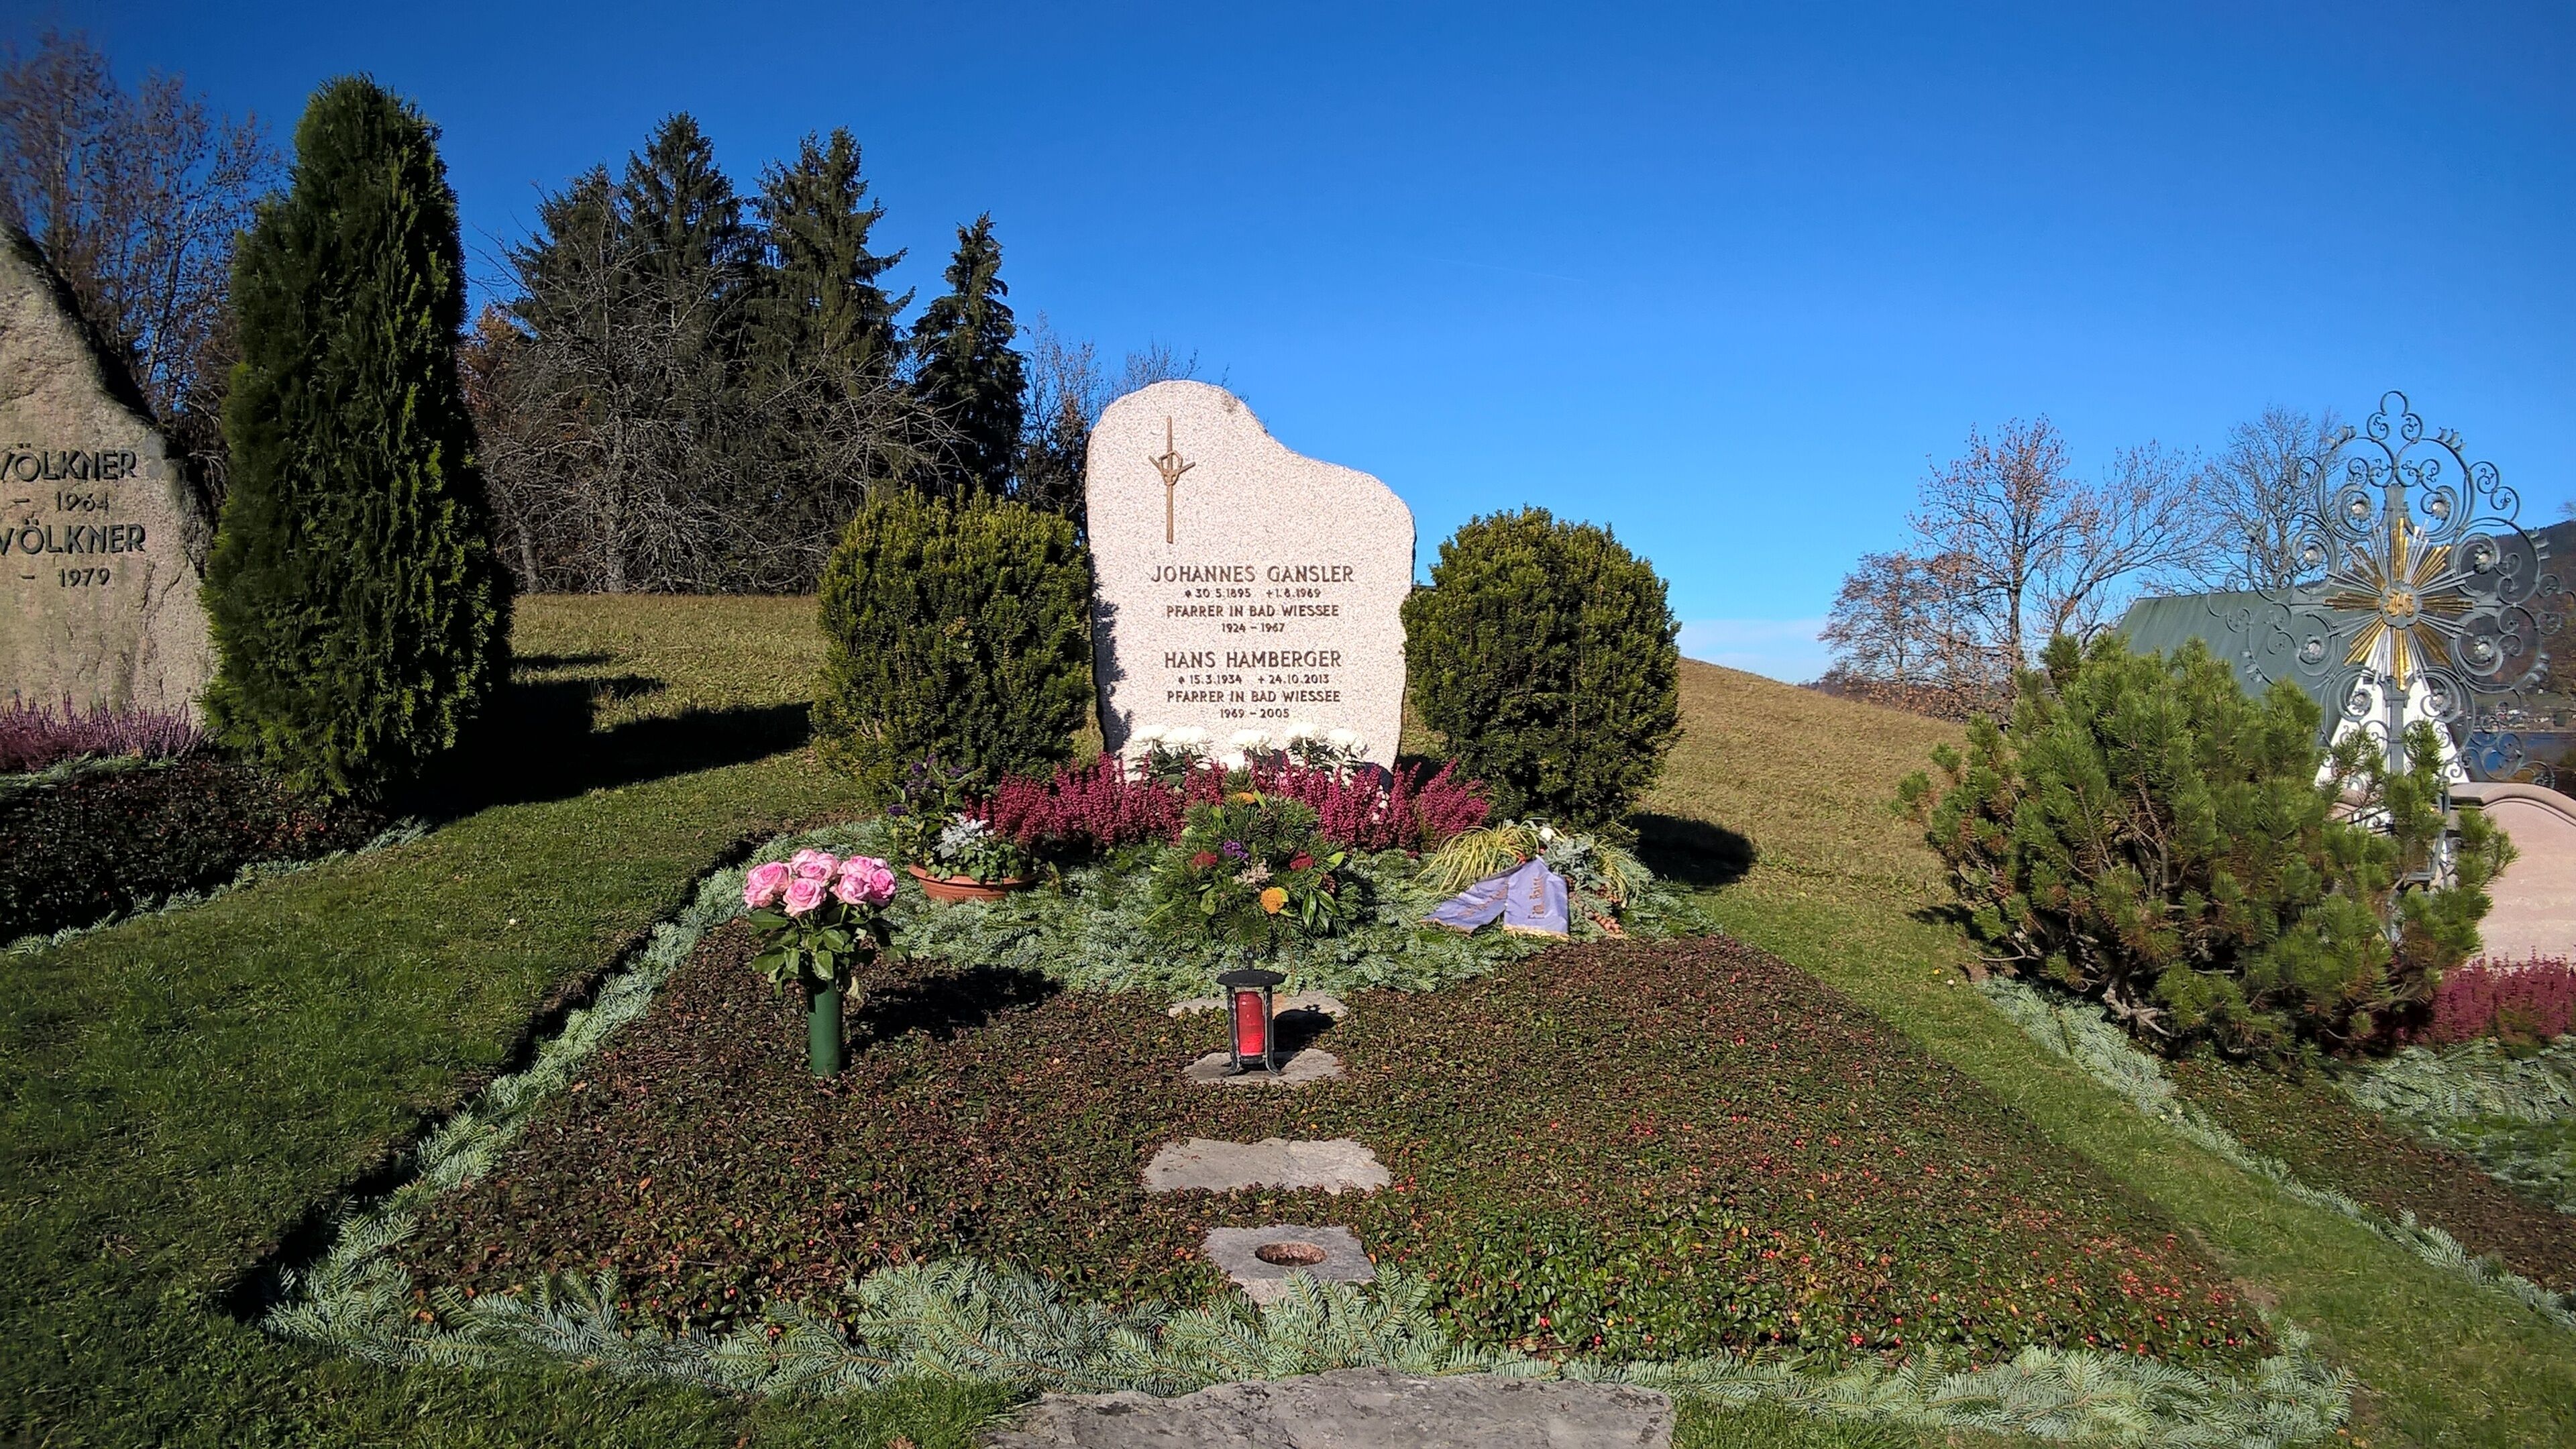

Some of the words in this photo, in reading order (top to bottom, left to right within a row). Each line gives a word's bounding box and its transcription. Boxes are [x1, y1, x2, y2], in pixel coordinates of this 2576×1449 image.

[55, 491, 109, 512] 1964
[59, 568, 110, 588] 1979
[1150, 566, 1256, 583] JOHANNES
[1267, 566, 1354, 583] GANSLER
[1167, 604, 1224, 618] PFARRER
[1229, 604, 1243, 617] IN
[1249, 604, 1275, 617] BAD
[1281, 604, 1339, 617] WIESSEE
[1222, 623, 1246, 633] 1924
[1260, 623, 1285, 633] 1967
[1164, 651, 1216, 669] HANS
[1226, 650, 1342, 668] HAMBERGER
[1167, 690, 1225, 702] PFARRER
[1230, 690, 1244, 702] IN
[1251, 690, 1277, 702] BAD
[1282, 690, 1341, 702] WIESSEE
[1220, 708, 1244, 718] 1969
[1260, 708, 1290, 718] 2005
